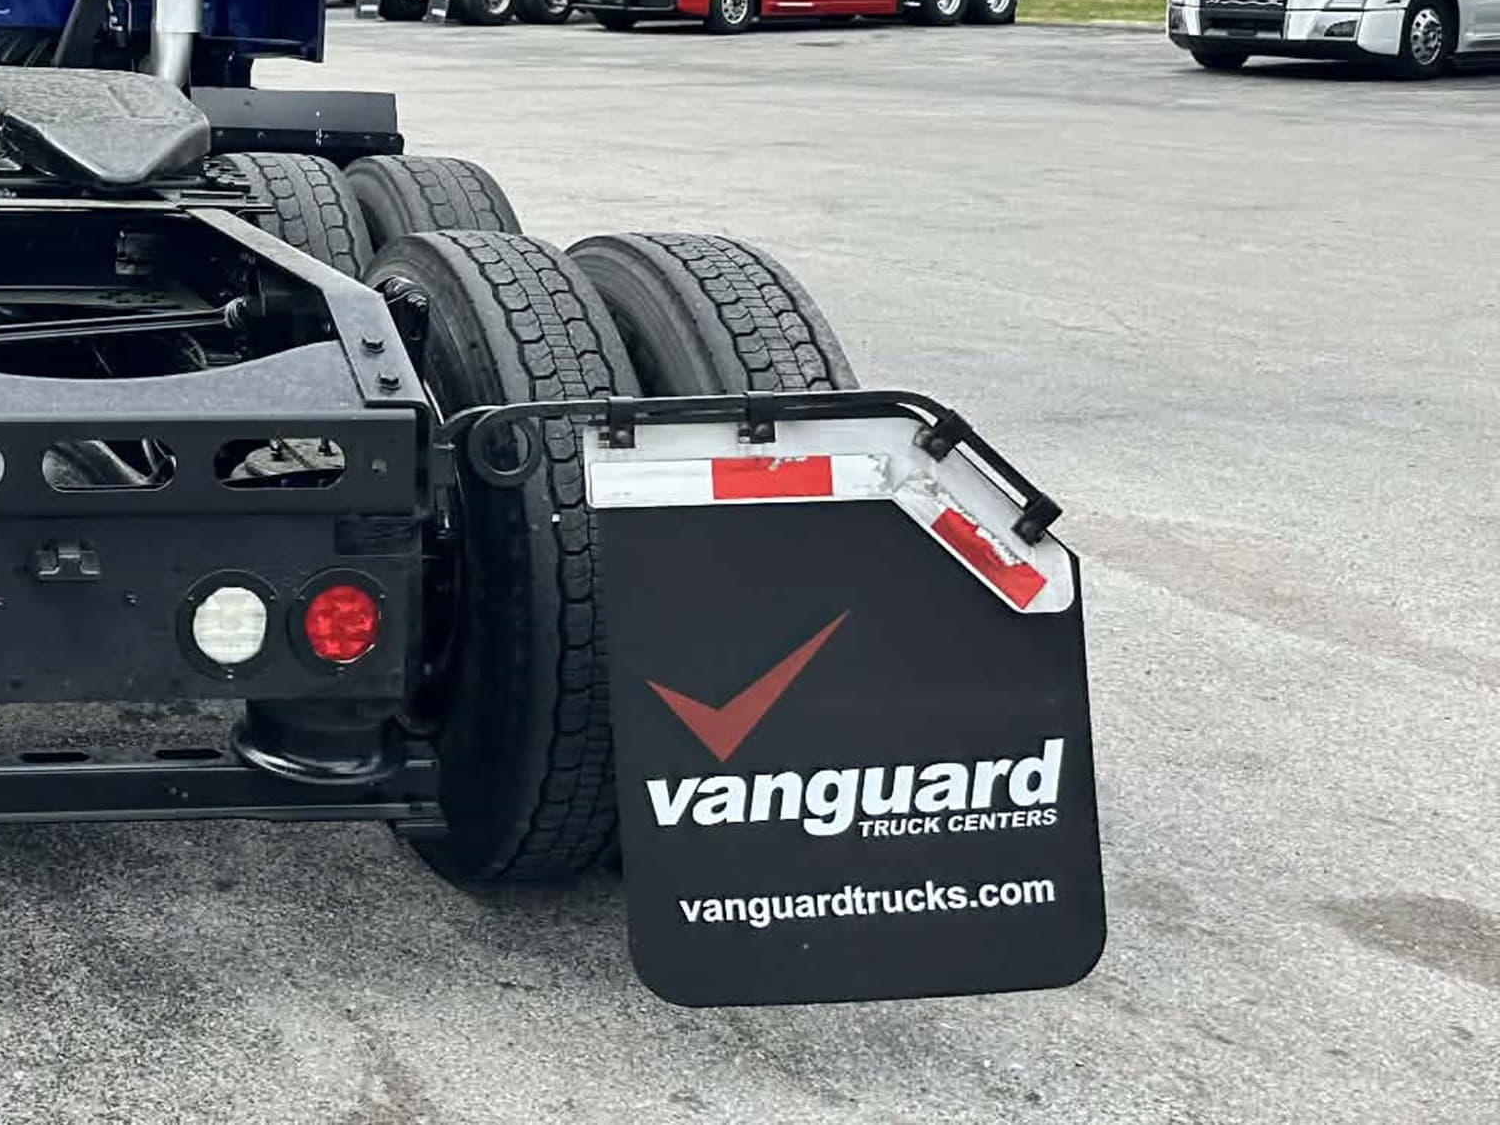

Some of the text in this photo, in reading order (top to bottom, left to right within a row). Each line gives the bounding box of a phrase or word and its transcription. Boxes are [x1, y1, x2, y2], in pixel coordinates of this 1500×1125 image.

[646, 738, 1065, 837] vanguard
[858, 807, 1058, 838] TRUCK CENTERS
[679, 879, 1056, 929] vanguardtrucks.com
